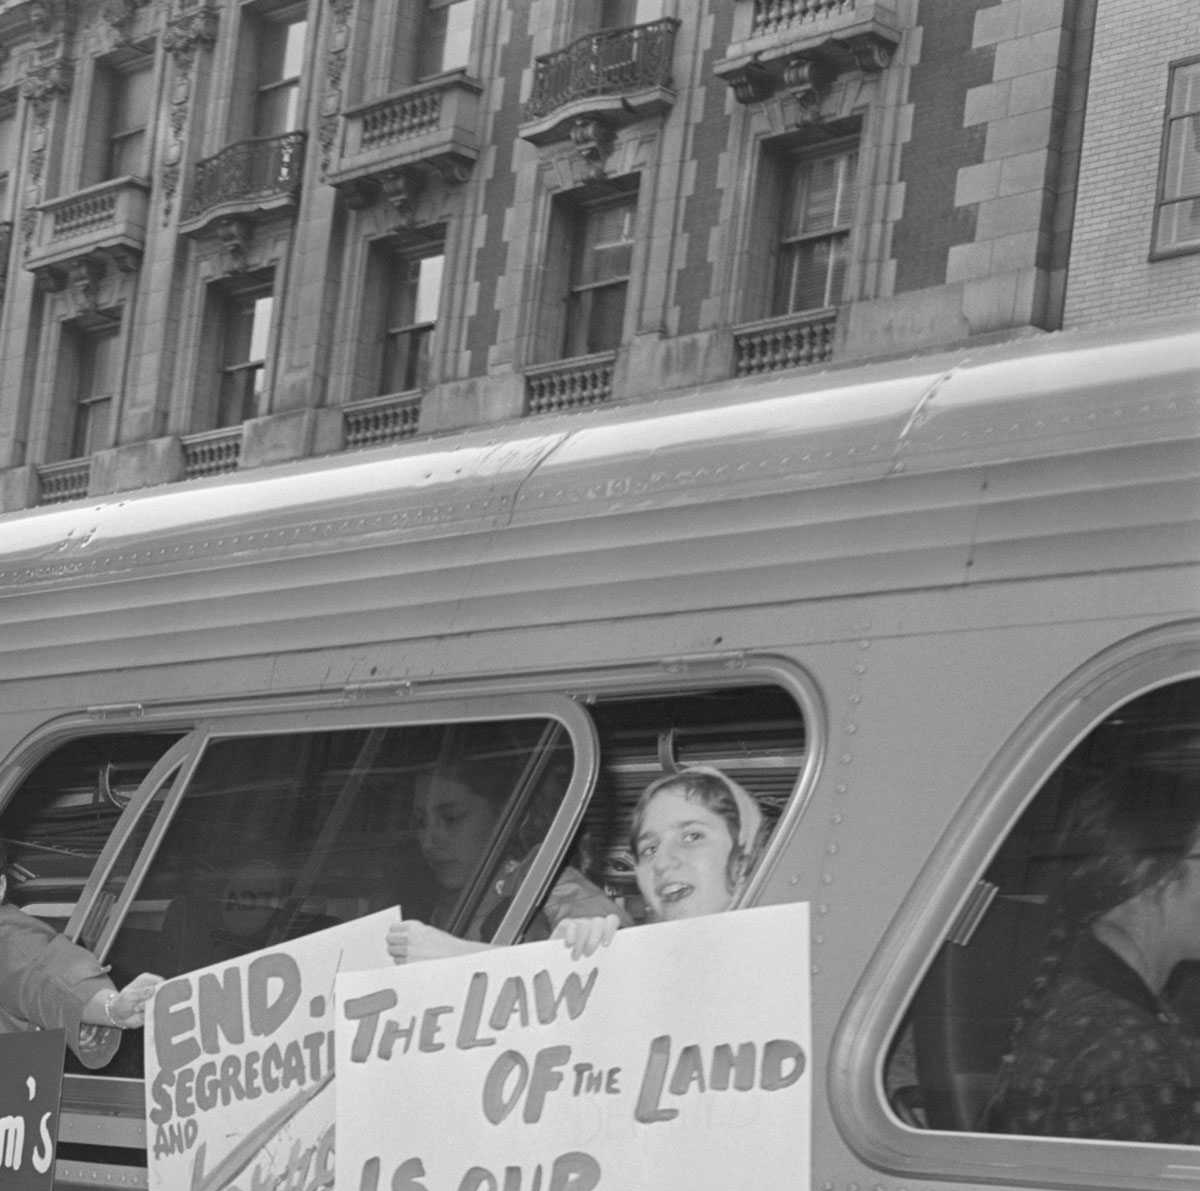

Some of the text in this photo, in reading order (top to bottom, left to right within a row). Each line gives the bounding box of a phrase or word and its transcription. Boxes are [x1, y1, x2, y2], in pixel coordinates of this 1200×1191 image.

[456, 967, 599, 1050] LAW
[482, 1034, 806, 1126] OF THE LAND
[153, 1118, 198, 1161] AND
